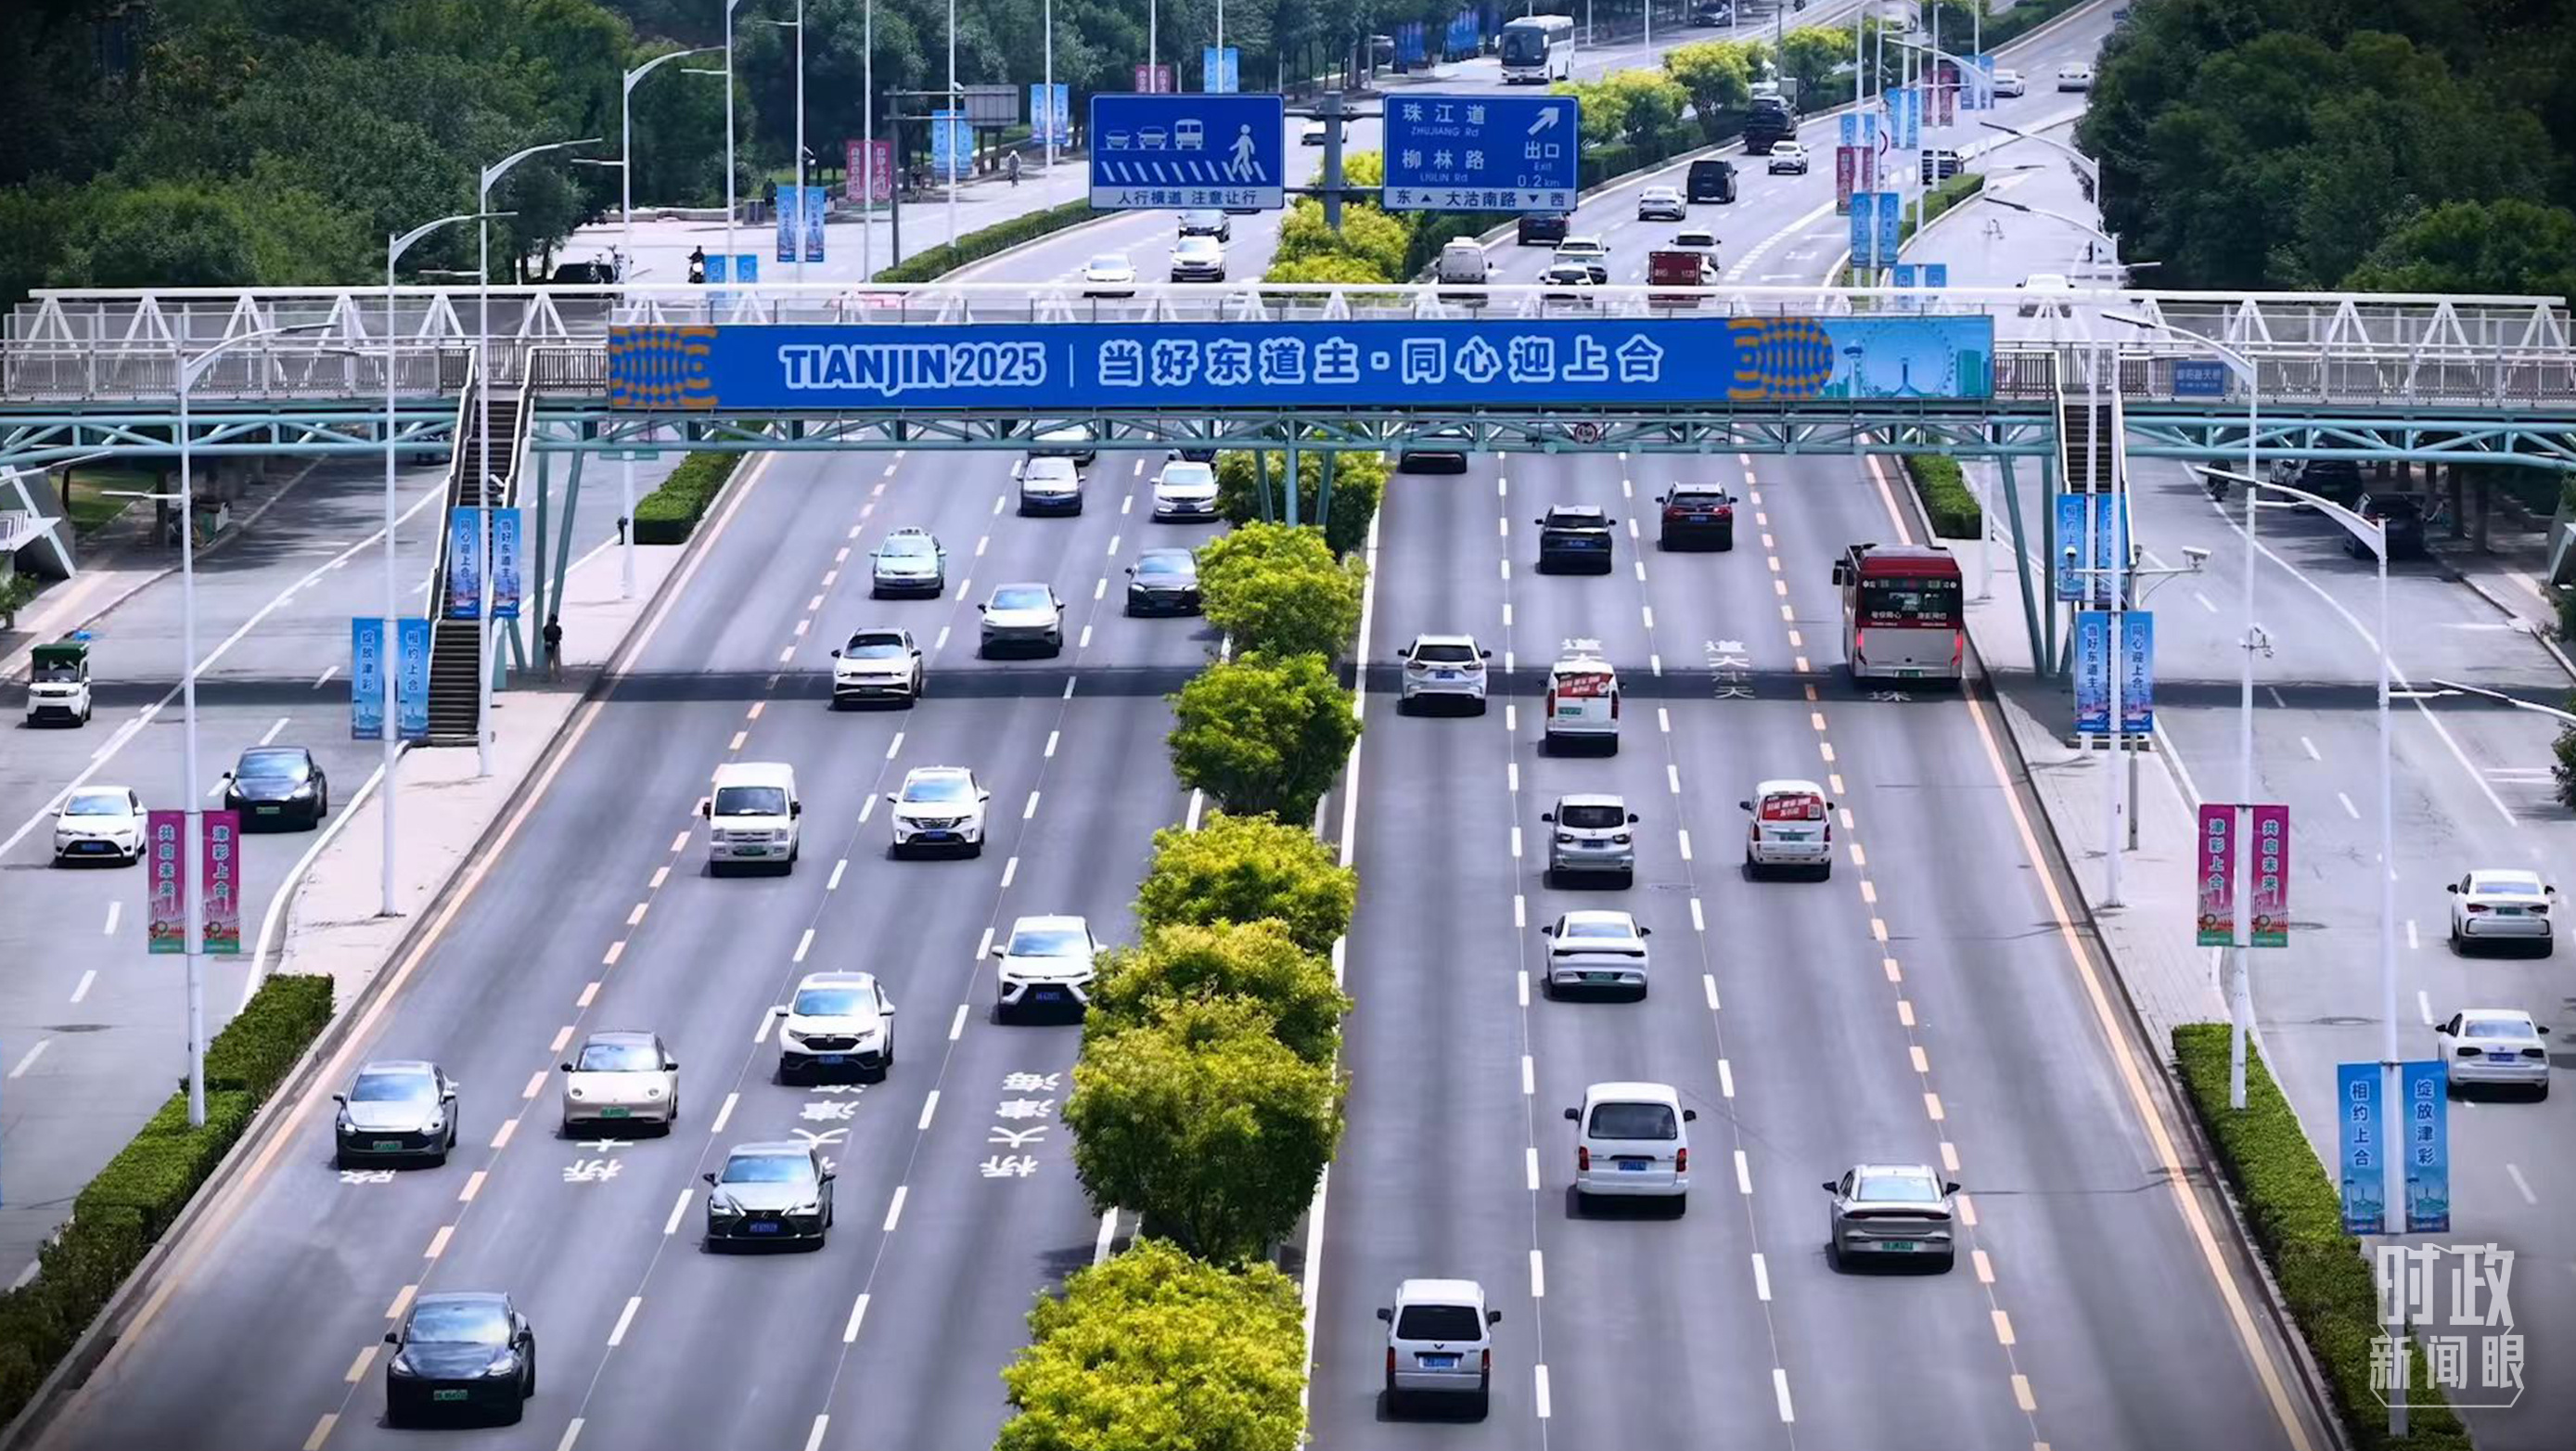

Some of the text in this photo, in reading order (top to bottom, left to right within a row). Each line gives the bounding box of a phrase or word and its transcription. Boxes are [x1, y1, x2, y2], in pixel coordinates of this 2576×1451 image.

[1403, 102, 1485, 124] 珠江道
[1411, 127, 1479, 136] ZHUJIANG Rd
[1402, 148, 1484, 170] 柳林路
[1524, 141, 1559, 159] 出口
[1118, 190, 1256, 204] 人行横道 注意让行
[1397, 190, 1565, 207] 东 大沽南路 西
[407, 631, 419, 692] 相约上合
[2086, 623, 2098, 688] 当好东道主
[2132, 623, 2144, 688] 同心迎上合
[159, 824, 174, 897] 共启未来
[212, 825, 229, 897] 津彩上合
[2209, 818, 2225, 890] 津彩上合
[2262, 819, 2279, 891] 共启未来
[2351, 1081, 2370, 1167] 相约上合
[2416, 1080, 2435, 1166] 绽放津彩
